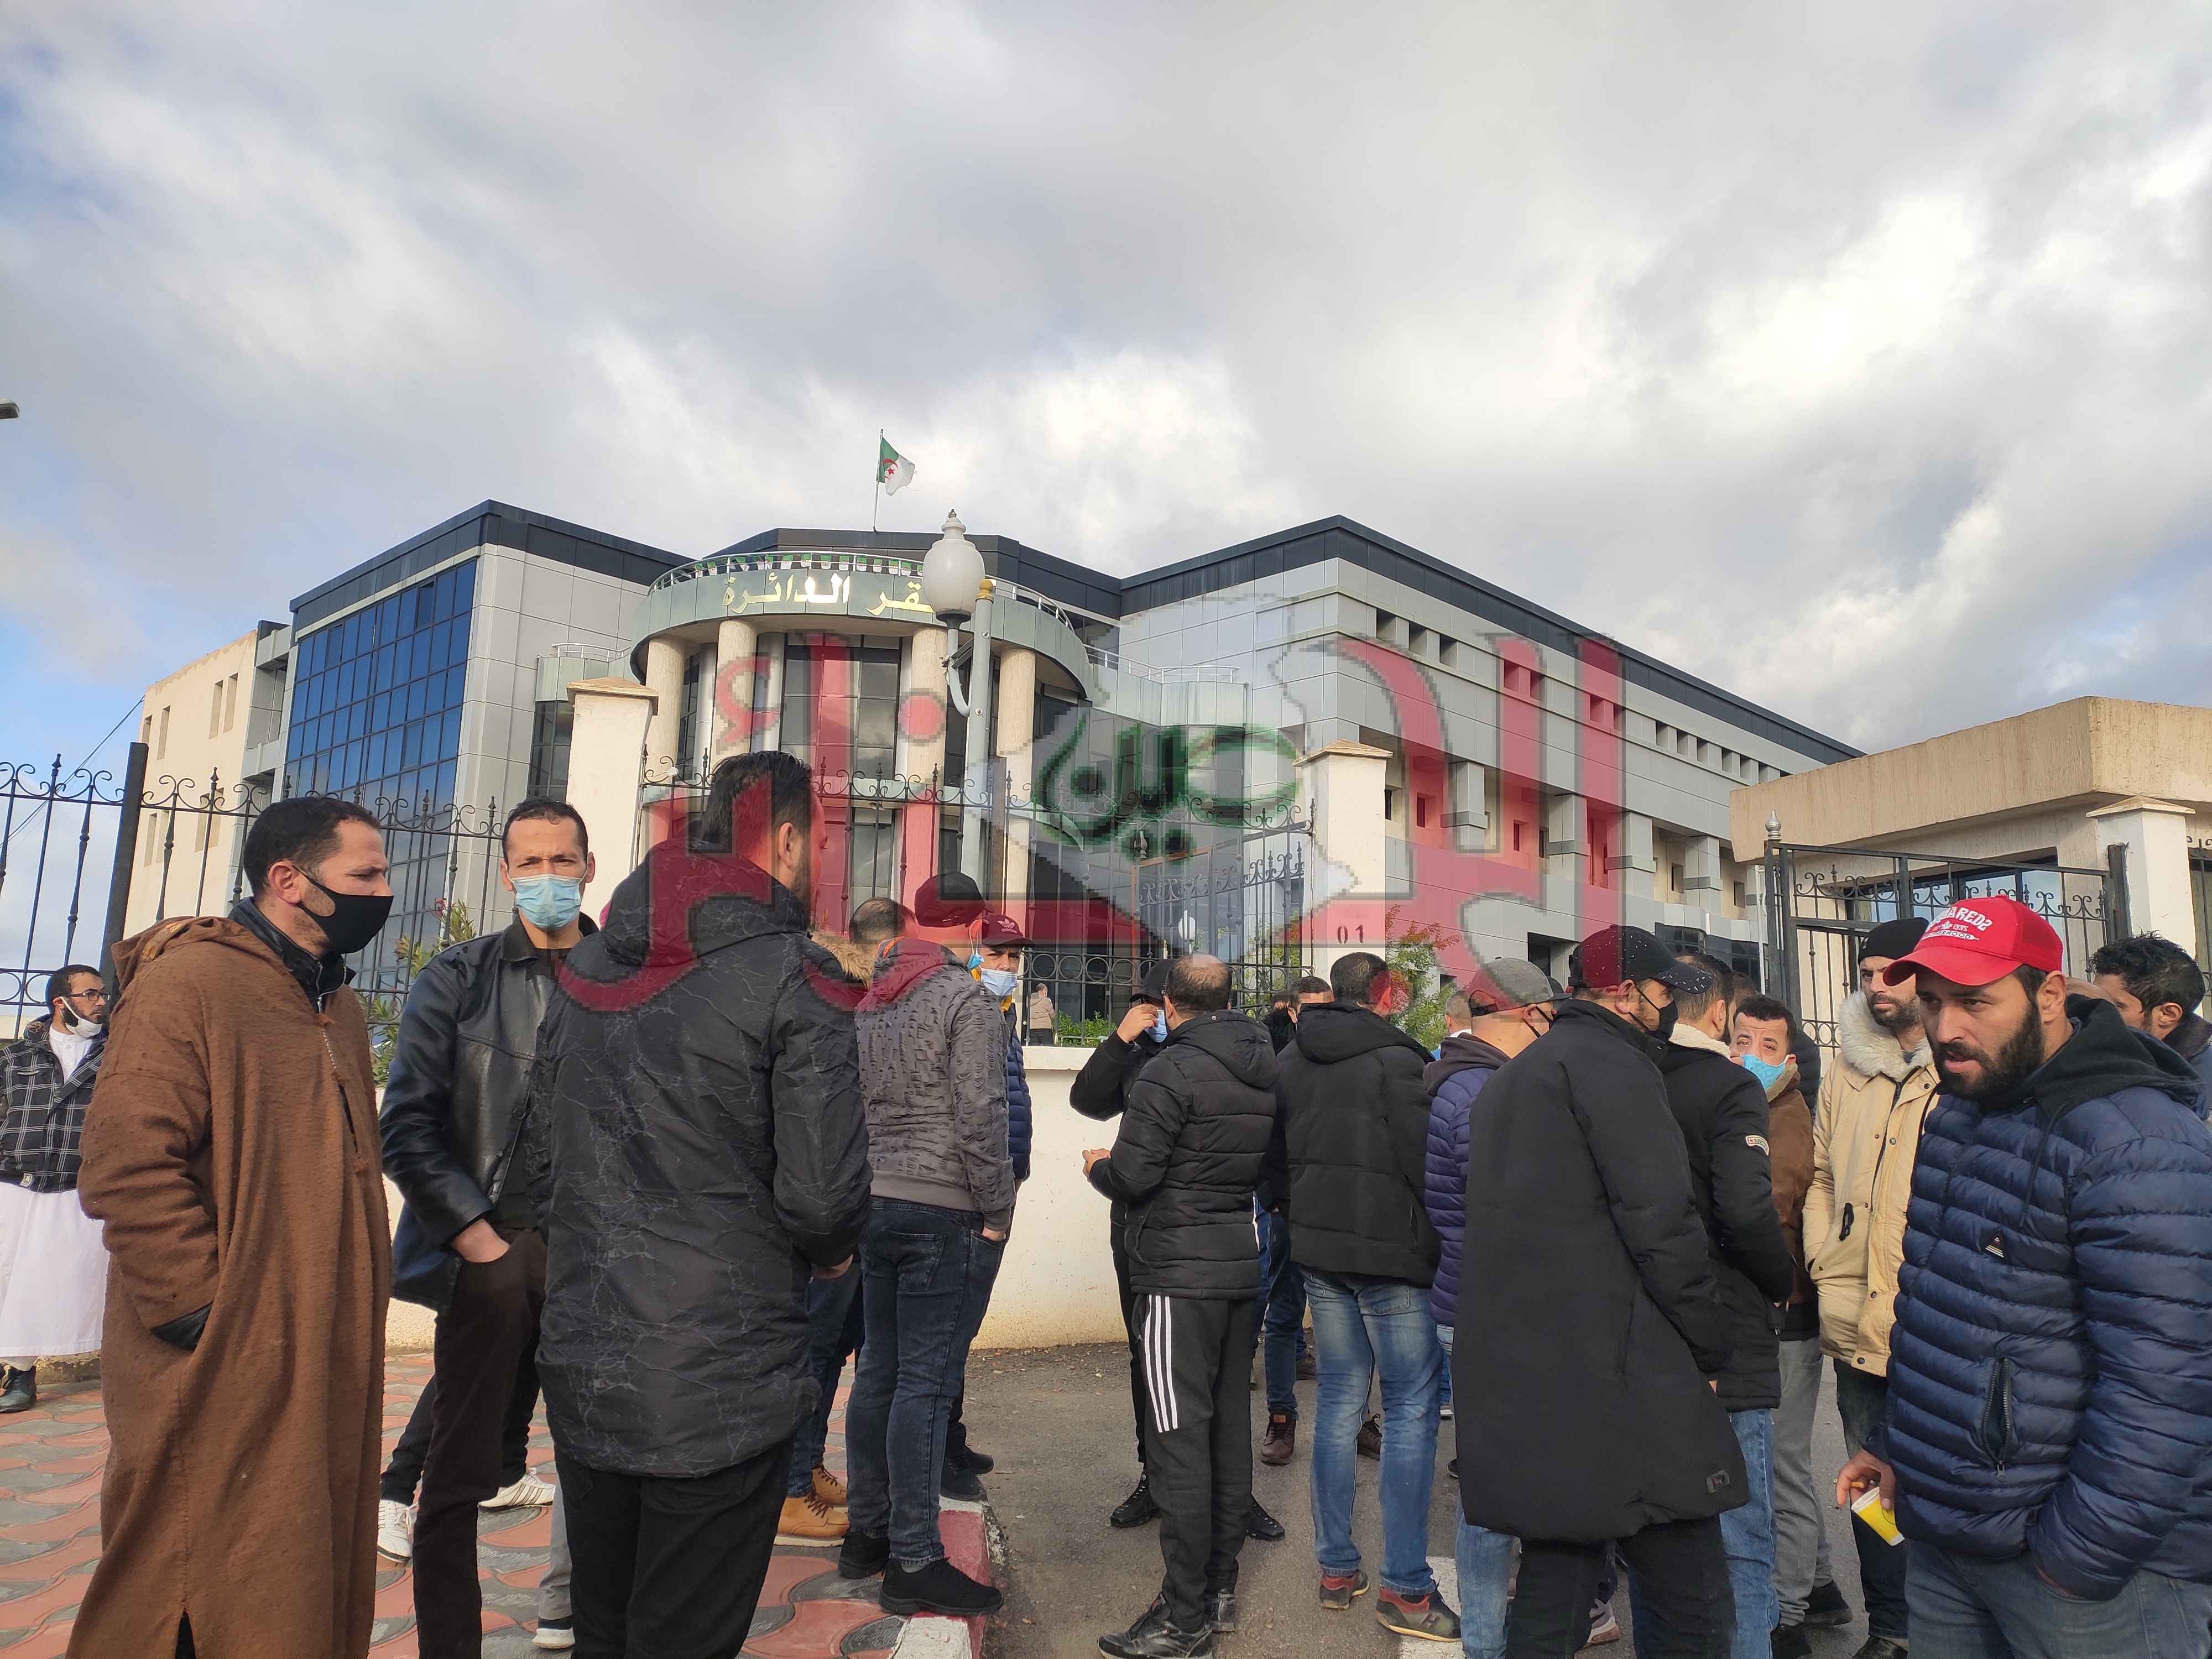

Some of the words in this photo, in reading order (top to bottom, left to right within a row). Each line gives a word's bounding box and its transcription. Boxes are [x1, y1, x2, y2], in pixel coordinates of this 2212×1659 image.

[723, 572, 851, 614] الدائرة
[866, 580, 936, 615] قر
[1337, 924, 1364, 945] 01
